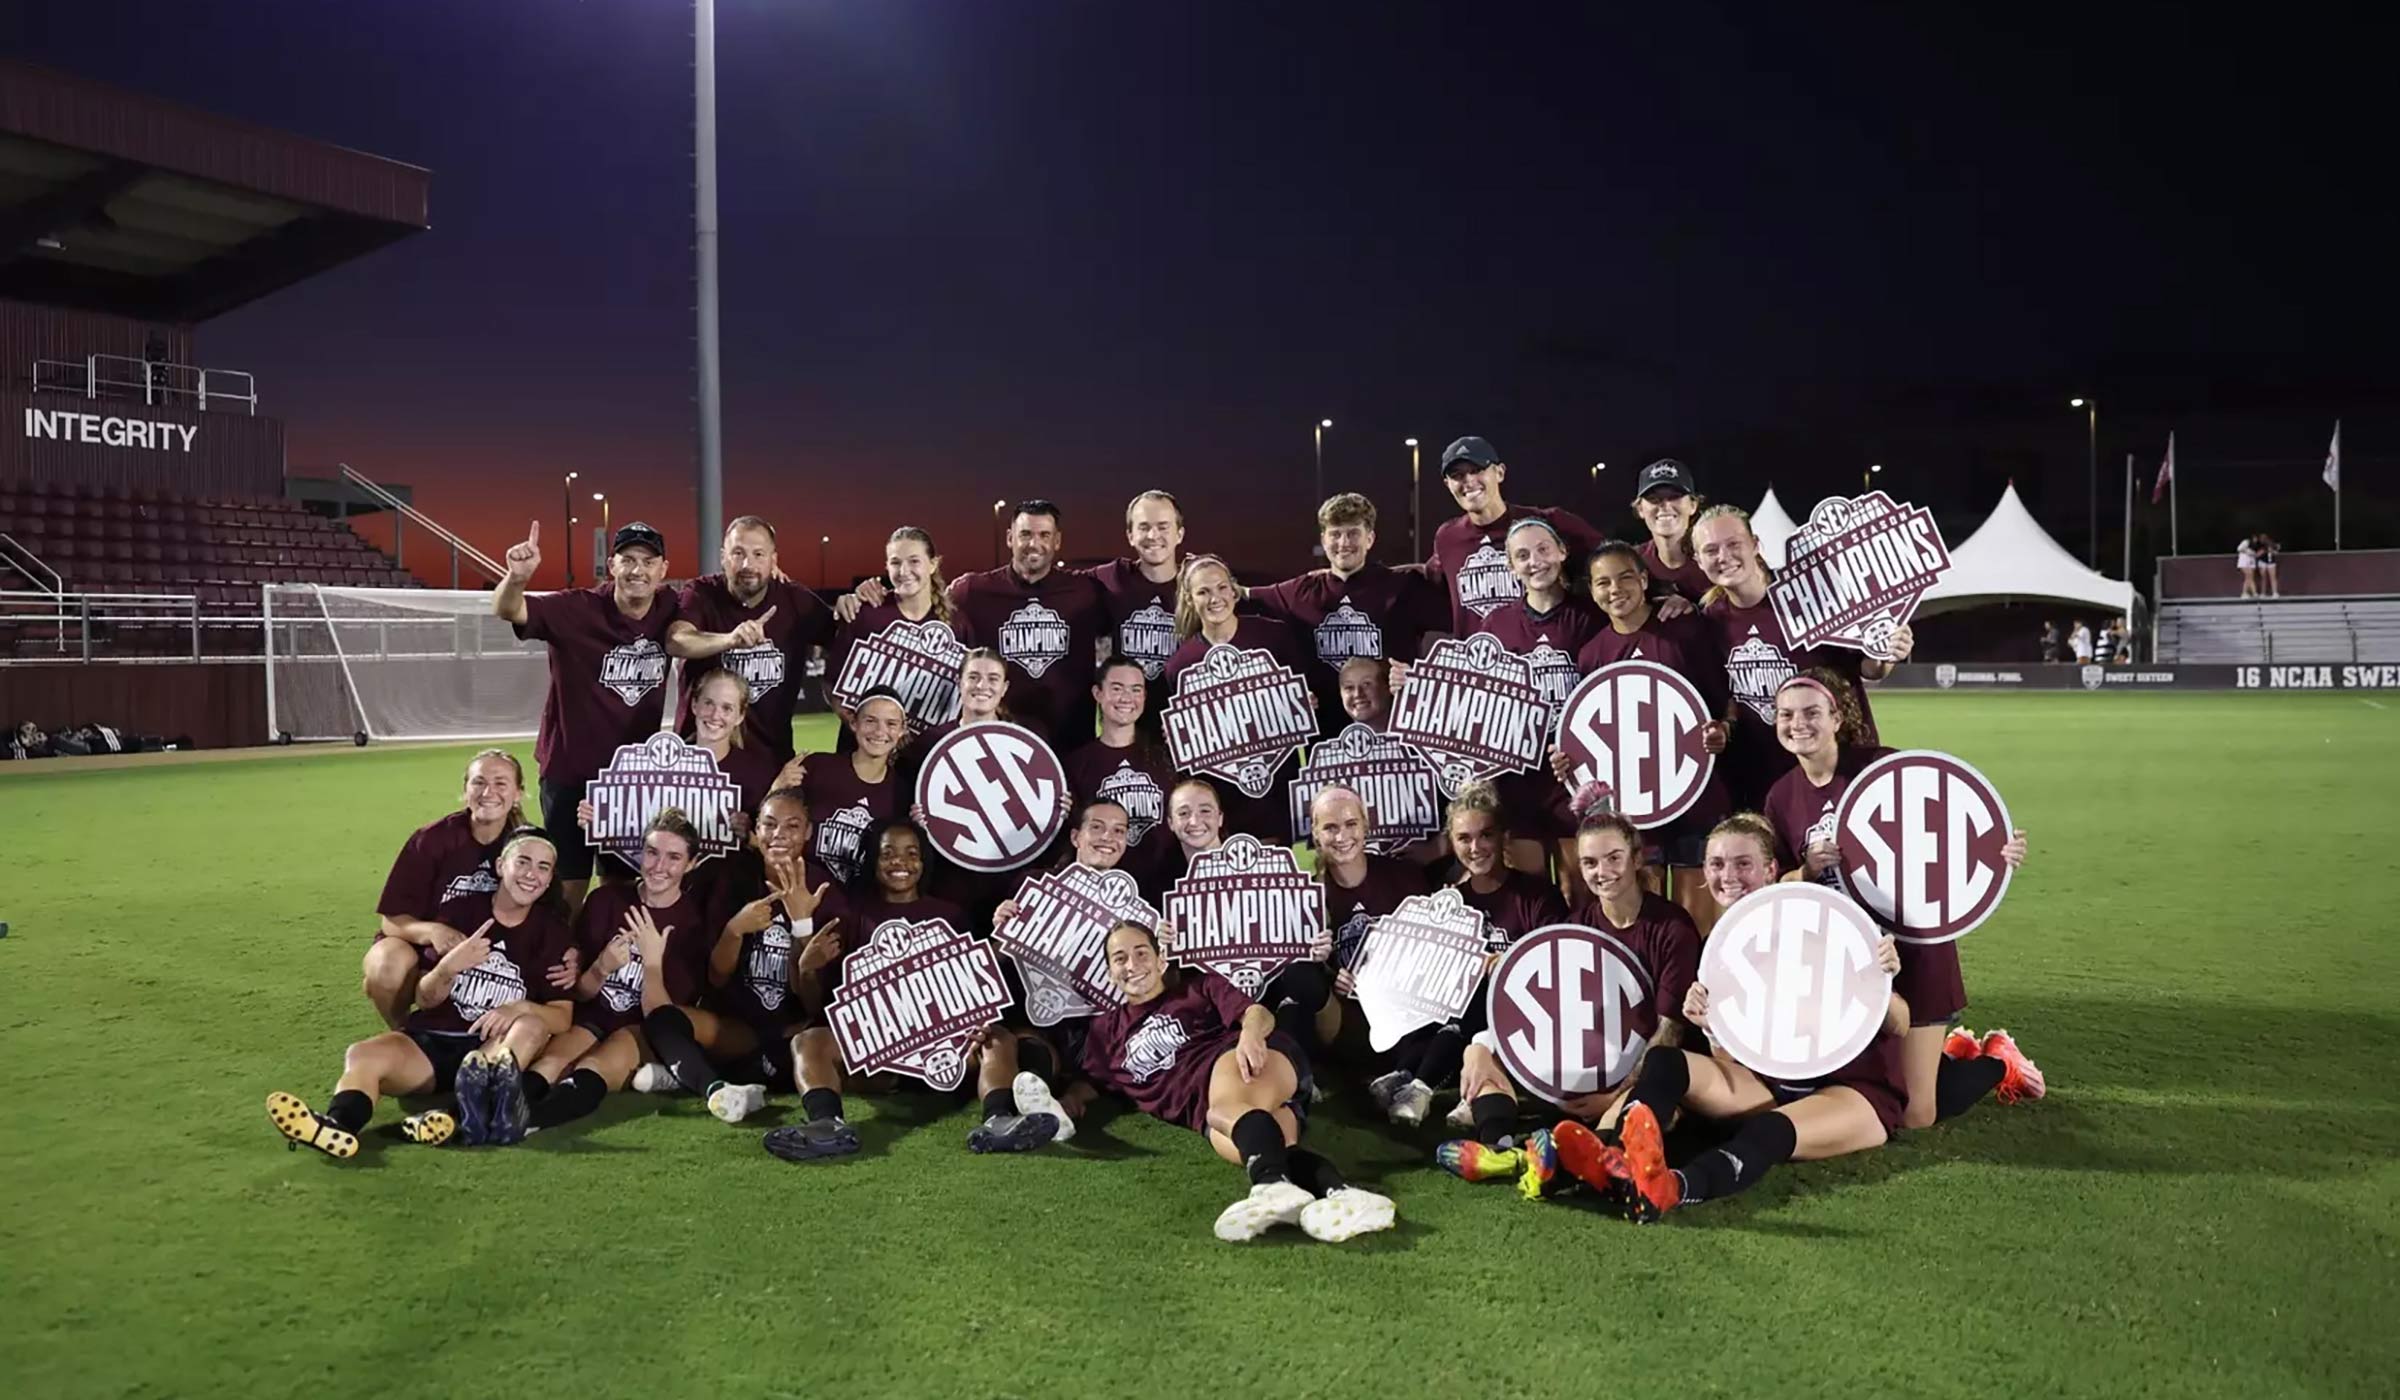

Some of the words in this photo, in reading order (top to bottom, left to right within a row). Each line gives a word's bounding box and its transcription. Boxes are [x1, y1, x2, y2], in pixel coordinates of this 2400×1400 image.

[25, 408, 197, 452] INTEGRITY
[1816, 502, 1849, 535] SEC
[1783, 539, 1844, 580] REGULAR
[1852, 510, 1908, 543] SEASON
[1776, 516, 1943, 639] CHAMPIONS
[1809, 607, 1863, 640] MISSISSIPPI
[1867, 592, 1893, 610] STATE
[872, 642, 925, 666] REGULAR
[923, 627, 950, 654] SEC
[1003, 628, 1067, 654] CHAMPIONS
[1317, 631, 1379, 656] CHAMPIONS
[1469, 640, 1497, 670] SEC
[1209, 649, 1238, 679] SEC
[2236, 667, 2261, 688] 16
[2270, 666, 2334, 688] NCAA
[2342, 666, 2400, 688] SWE
[842, 647, 961, 725] CHAMPION
[1176, 686, 1231, 709] REGULAR
[1239, 674, 1287, 692] SEASON
[1418, 667, 1477, 686] REGULAR
[1485, 680, 1536, 702] SEASON
[1168, 682, 1311, 764] CHAMPIONS
[1396, 676, 1545, 760] CHAMPIONS
[651, 738, 679, 767] SEC
[1344, 730, 1371, 757] SEC
[1569, 674, 1699, 815] SEC
[605, 774, 664, 785] REGULAR
[672, 776, 723, 788] SEASON
[1305, 765, 1360, 782] REGULAR
[1368, 760, 1417, 773] SEASON
[927, 733, 1055, 860] SEC
[1295, 772, 1432, 836] CPIONS
[1228, 841, 1258, 870] SEC
[1847, 765, 1994, 929] SEC
[1044, 882, 1102, 921] REGULAR
[1101, 876, 1131, 908] SEC
[1182, 878, 1243, 894] REGULAR
[1252, 878, 1304, 888] SEASON
[1170, 888, 1319, 952] CHAMPIONS
[1430, 894, 1458, 922] SEC
[878, 926, 910, 959] SEC
[1003, 887, 1127, 1005] CHAMPI
[1186, 948, 1239, 960] MISSISSIPPI
[1382, 921, 1433, 939] REGULAR
[1437, 933, 1480, 953] SEASON
[842, 967, 905, 1002] REGULAR
[913, 941, 968, 969] SEASON
[1717, 898, 1871, 1063] SEC
[835, 948, 1003, 1063] CHAMPIONS
[1503, 939, 1648, 1092] SEC
[870, 1035, 925, 1066] MISSISSIPPI
[928, 1023, 955, 1039] STATE
[958, 1008, 993, 1026] SOCCER
